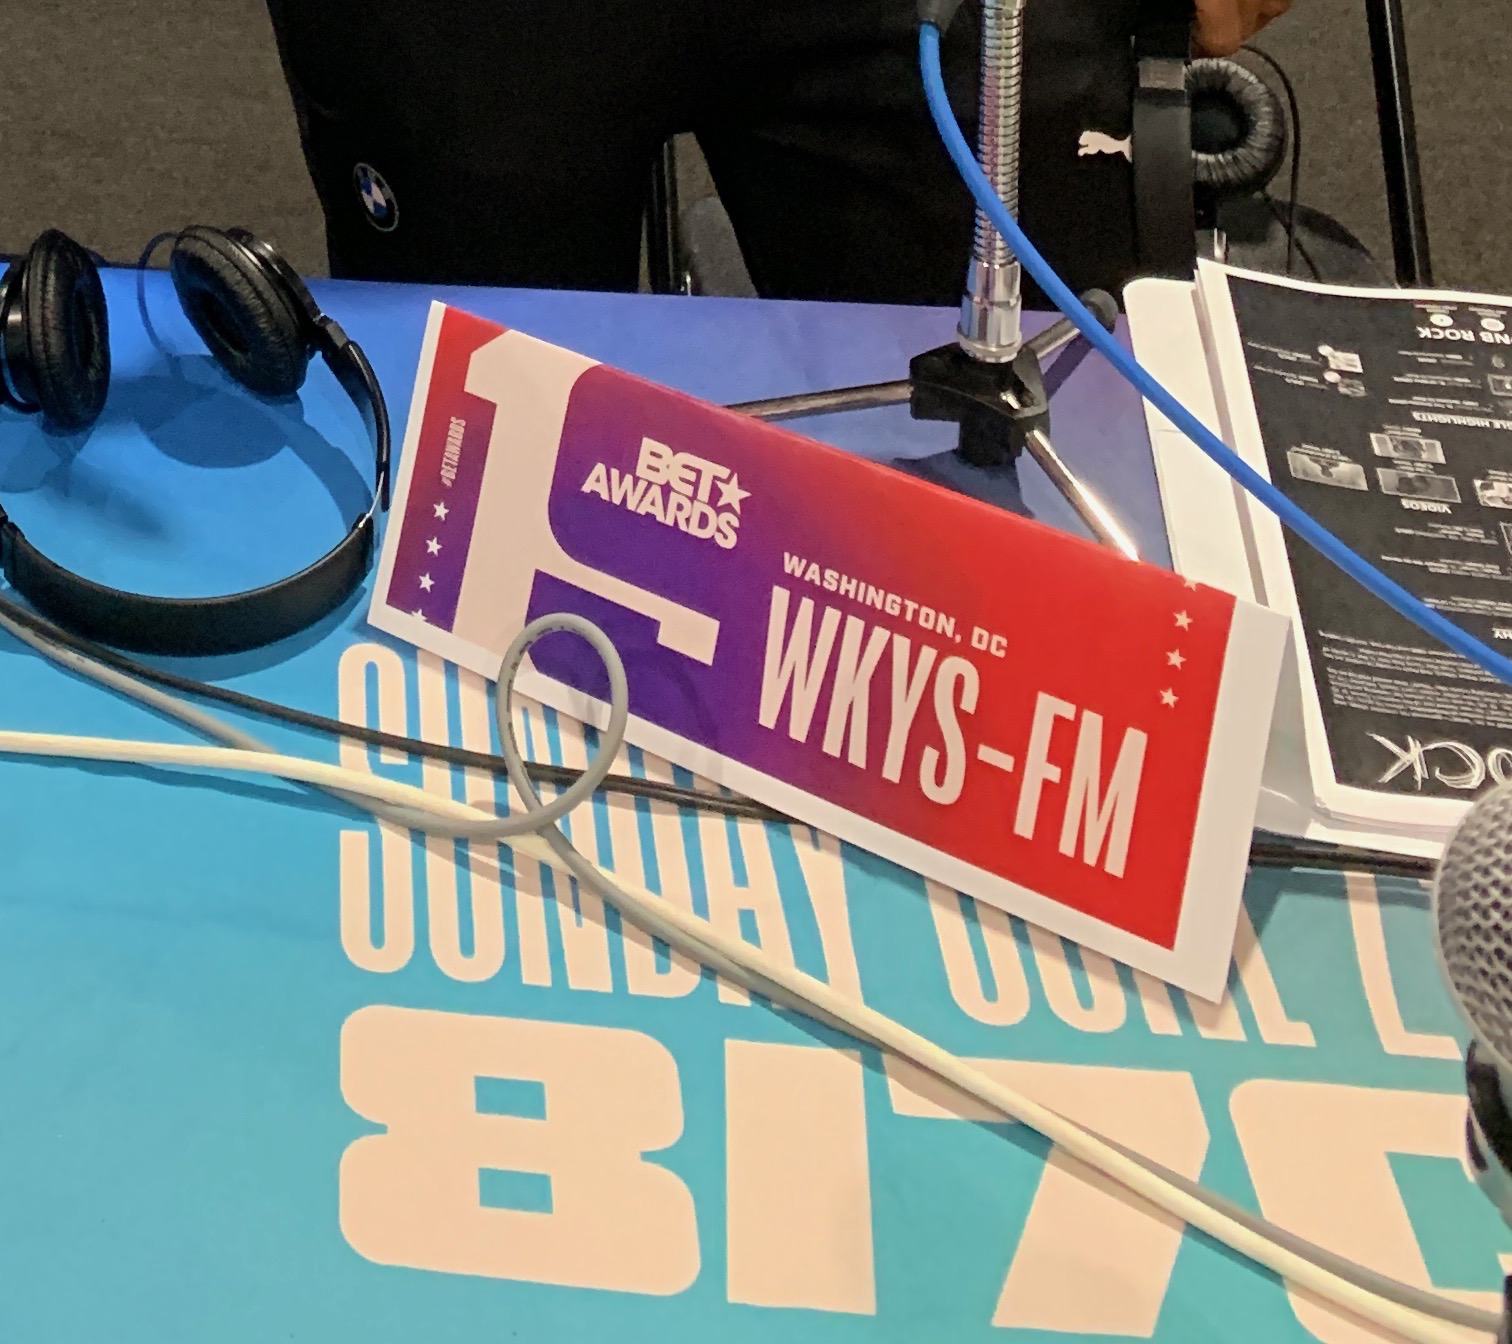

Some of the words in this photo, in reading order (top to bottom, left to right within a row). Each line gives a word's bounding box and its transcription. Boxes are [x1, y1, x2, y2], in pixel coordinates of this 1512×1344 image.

[1415, 326, 1475, 344] ROCK
[581, 462, 740, 550] AWARDS
[635, 436, 734, 505] BET
[1400, 498, 1453, 515] VIDEOS
[782, 551, 962, 644] WASHINGTON,
[970, 625, 1009, 659] DC
[758, 585, 1149, 879] WKYS-FM
[337, 641, 866, 1011] SUNDAY
